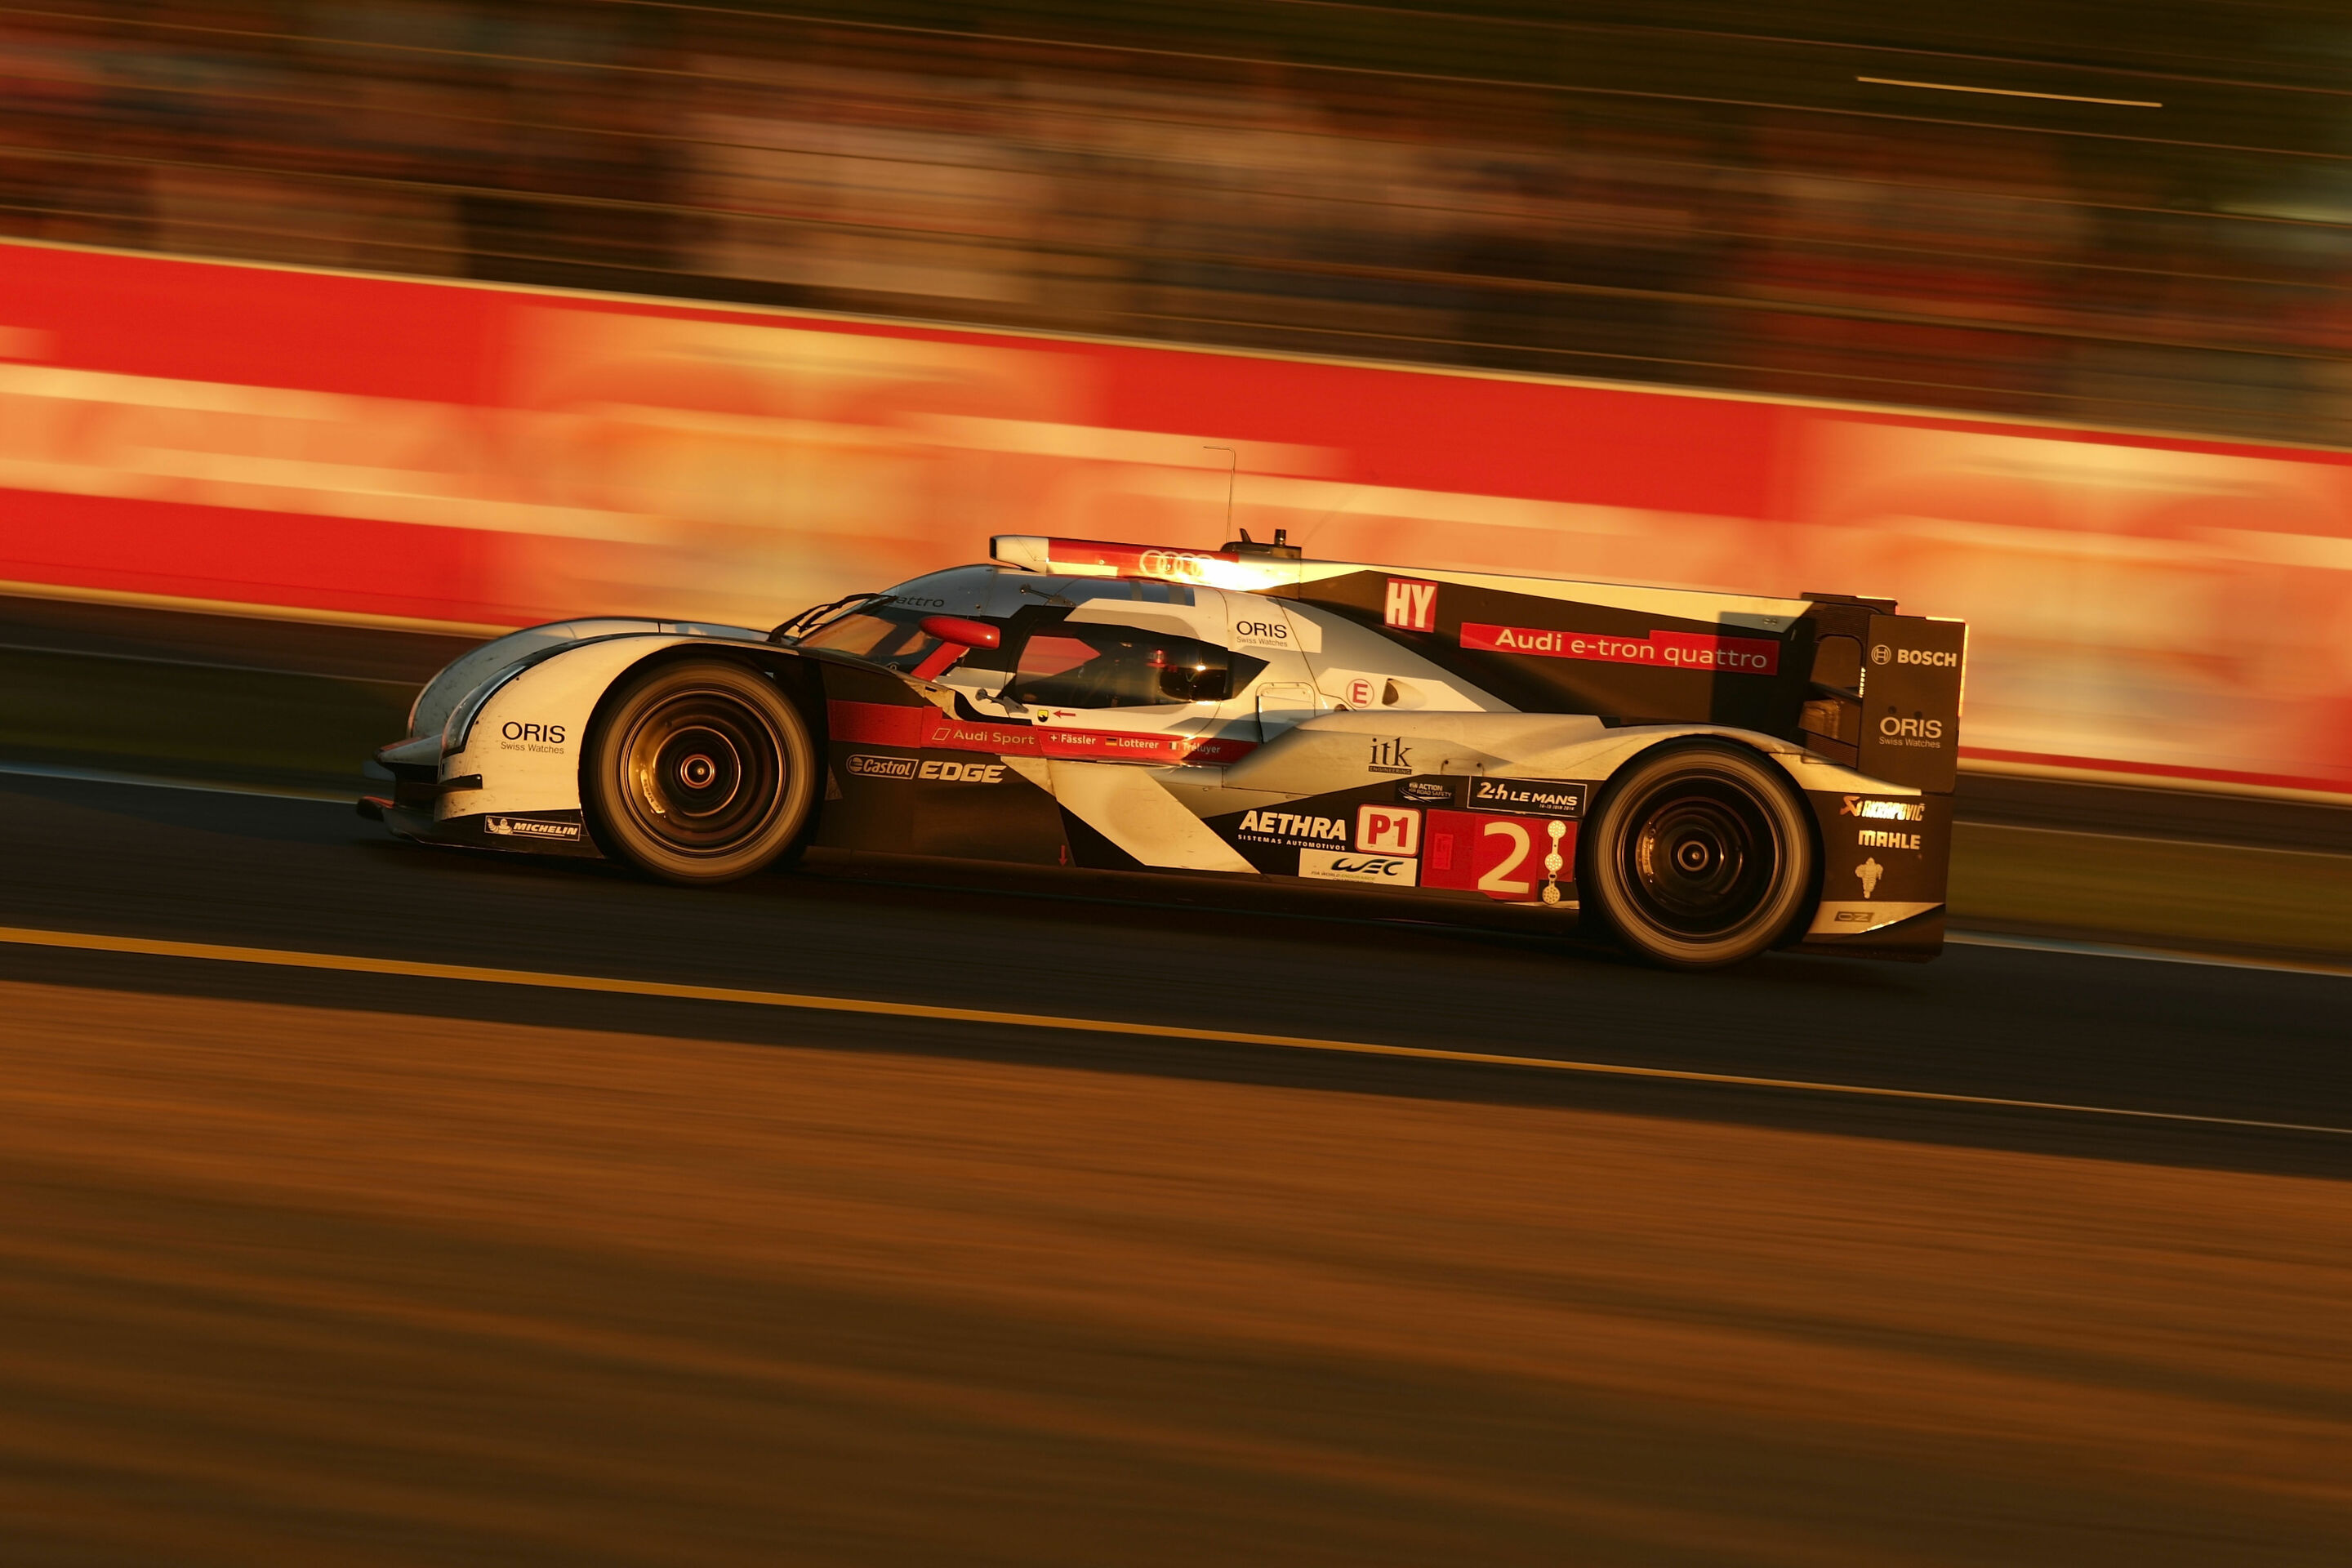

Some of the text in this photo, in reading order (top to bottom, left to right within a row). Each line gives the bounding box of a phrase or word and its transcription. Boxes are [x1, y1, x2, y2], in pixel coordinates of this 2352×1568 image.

[897, 596, 945, 608] attro
[1386, 582, 1436, 628] HY
[1236, 621, 1287, 639] ORIS
[1236, 636, 1288, 647] Swiss Watches
[1494, 629, 1767, 668] Audi e-tron quattro
[1897, 649, 1957, 667] BOSCH
[1352, 683, 1368, 704] E
[501, 721, 566, 744] ORIS
[1879, 716, 1942, 738] ORIS
[953, 729, 1035, 745] Audi Sport
[1061, 734, 1221, 754] Fässler Lotterer Tréluyer
[1878, 737, 1940, 748] Swiss Watches
[501, 741, 564, 755] Swiss Watches
[1369, 737, 1413, 767] itk
[862, 758, 1007, 783] Castrol EDGE
[1370, 767, 1411, 775] ENGINEERING
[1509, 791, 1530, 802] LE
[1531, 792, 1578, 806] MANS
[513, 822, 578, 835] MICHELIN
[1239, 810, 1346, 840] AETHRA
[1368, 813, 1409, 848] P1
[1237, 835, 1346, 850] SISTEMAS AUTOMOTIVOS
[1858, 830, 1921, 849] MAHLE
[1331, 858, 1405, 876] WEC
[1477, 822, 1530, 894] 2
